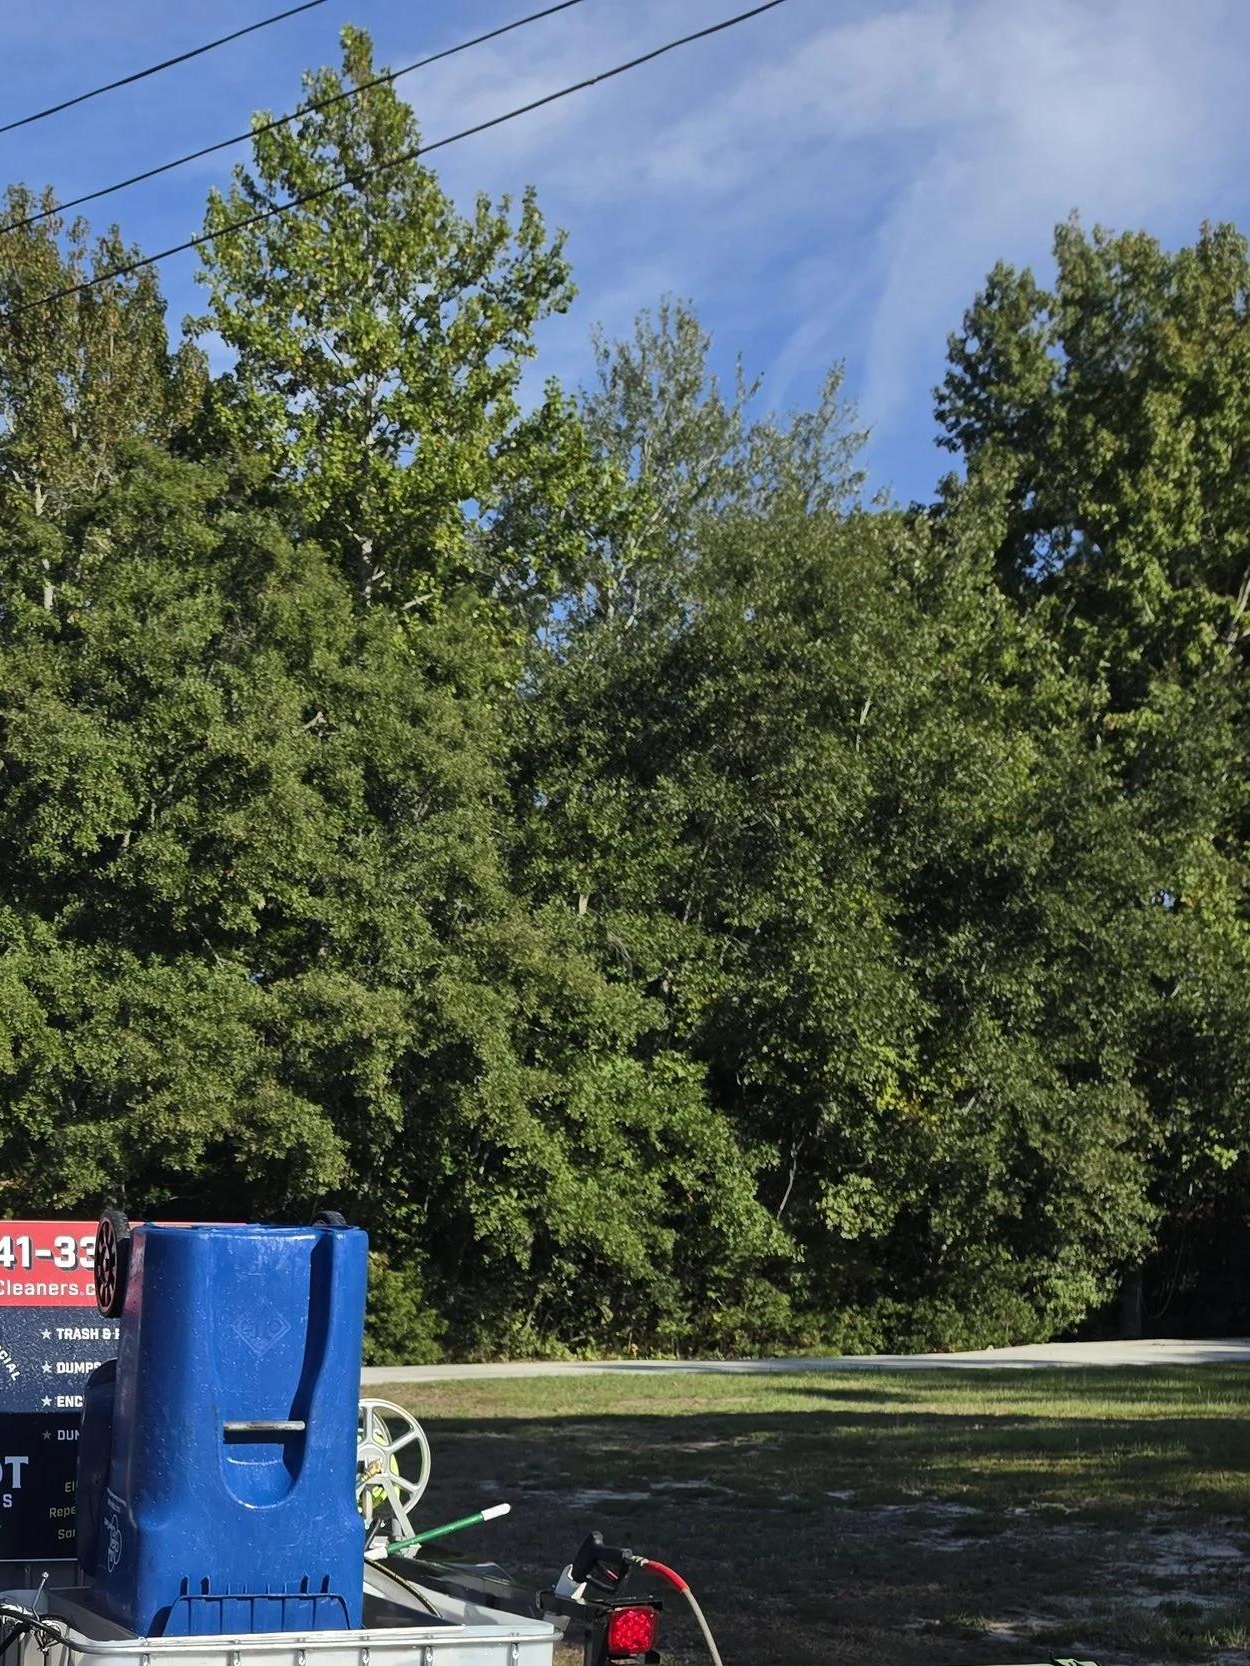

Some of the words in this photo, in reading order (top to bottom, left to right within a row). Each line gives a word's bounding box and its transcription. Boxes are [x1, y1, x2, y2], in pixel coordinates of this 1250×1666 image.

[56, 1327, 99, 1340] TRASH
[102, 1327, 111, 1340] &
[56, 1395, 84, 1408] ENC
